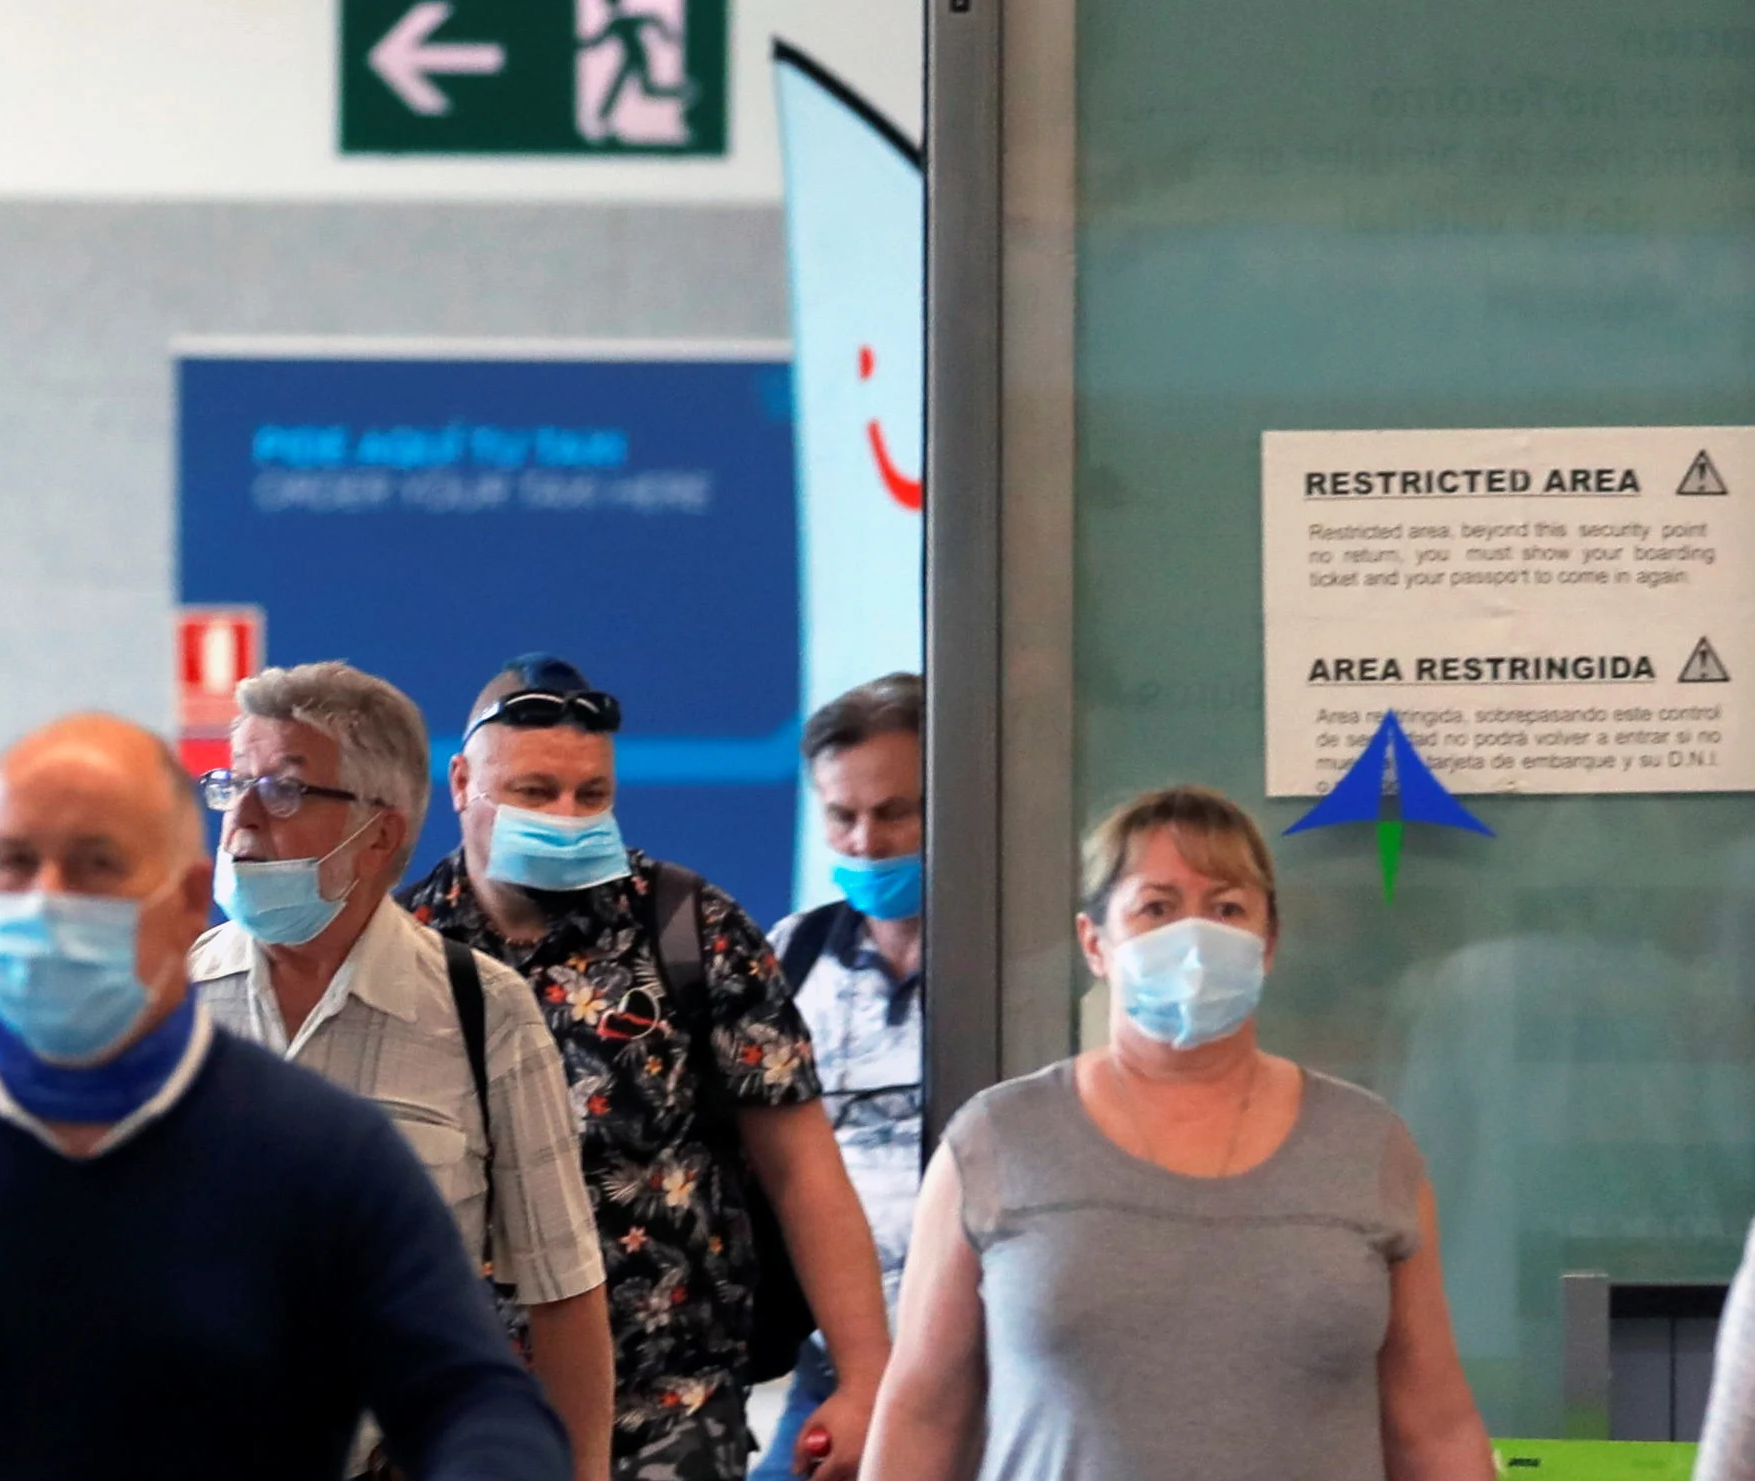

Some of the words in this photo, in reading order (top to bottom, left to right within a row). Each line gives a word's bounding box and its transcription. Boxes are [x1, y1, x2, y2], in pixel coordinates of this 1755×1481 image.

[1305, 469, 1532, 496] RESTRICTED
[1543, 468, 1641, 493] AREA
[1308, 523, 1403, 540] Restricted
[1460, 522, 1529, 542] beyond
[1533, 521, 1567, 538] this
[1578, 521, 1651, 541] security
[1661, 522, 1708, 541] point
[1308, 550, 1333, 564] no
[1415, 549, 1450, 566] you
[1464, 546, 1513, 562] must
[1521, 545, 1570, 561] show
[1582, 547, 1624, 565] your
[1633, 545, 1715, 565] boarding
[1309, 571, 1359, 588] ticket
[1363, 571, 1400, 587] and
[1404, 572, 1446, 590] your
[1449, 569, 1531, 589] passport
[1533, 569, 1552, 584] to
[1556, 571, 1609, 584] come
[1613, 569, 1630, 584] in
[1308, 657, 1402, 682] AREA
[1415, 655, 1656, 682] RESTRINGIDA
[1474, 705, 1608, 726] sobrepasando
[1613, 706, 1653, 723] este
[1658, 703, 1722, 723] control
[1316, 731, 1340, 748] de
[1442, 733, 1469, 748] no
[1534, 730, 1590, 746] volver
[1596, 733, 1609, 746] a
[1613, 731, 1671, 745] entrar
[1676, 729, 1692, 745] si
[1696, 731, 1723, 745] no
[1426, 753, 1485, 775] tarjeta
[1490, 753, 1515, 770] de
[1521, 753, 1617, 773] embarque
[1621, 756, 1634, 772] y
[1639, 754, 1661, 769] su
